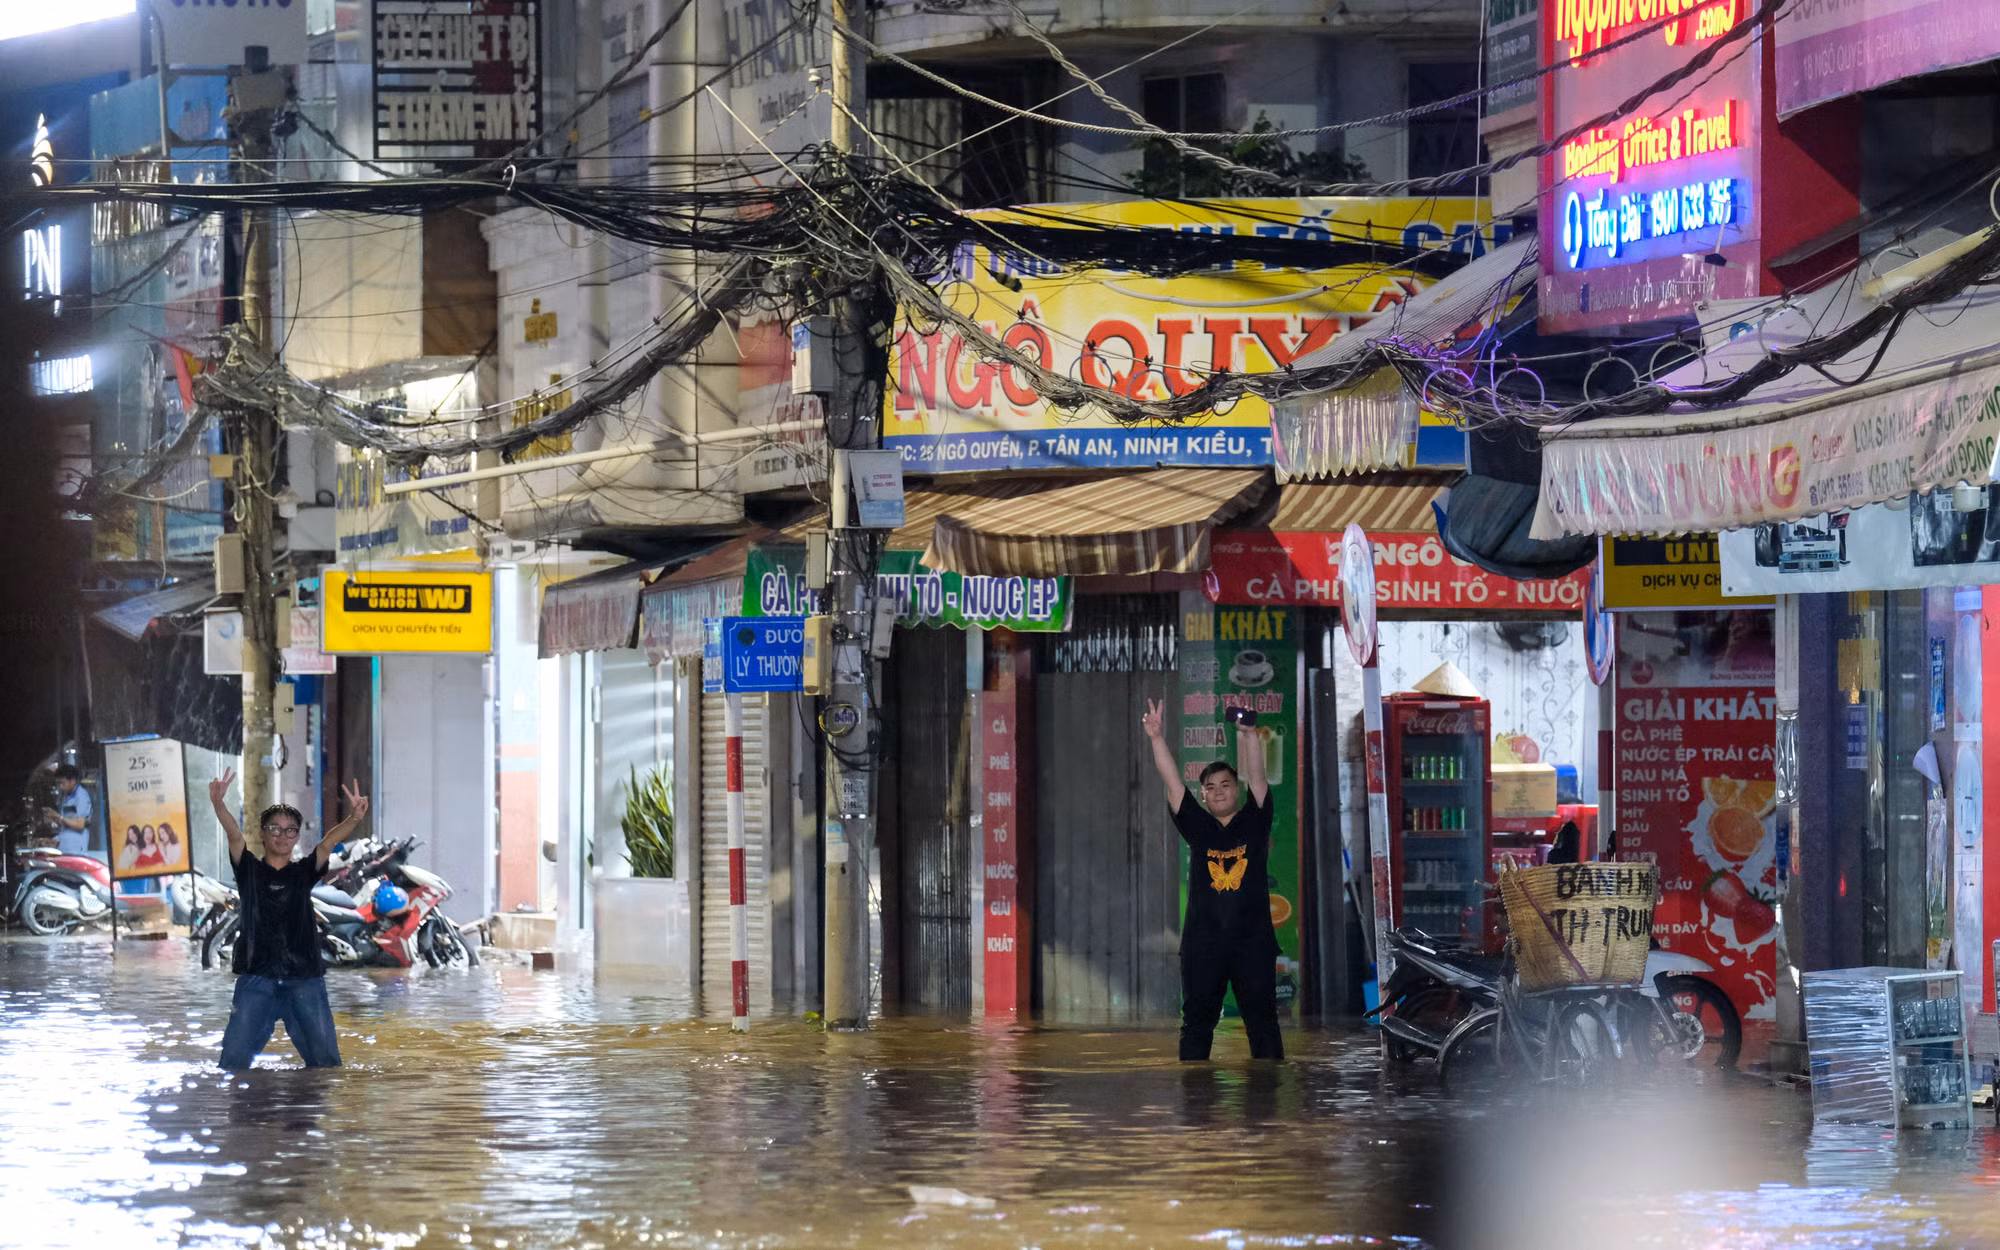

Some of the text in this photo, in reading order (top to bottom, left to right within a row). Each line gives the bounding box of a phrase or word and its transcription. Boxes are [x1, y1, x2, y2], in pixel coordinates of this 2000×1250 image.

[1565, 99, 1732, 184] Booking Office & Travel
[1585, 188, 1618, 258] Tổng
[1650, 187, 1679, 237] 1900
[1682, 182, 1705, 231] 633
[1708, 178, 1732, 224] 365
[894, 298, 1055, 411] NGÔ
[936, 438, 967, 461] NGÔ
[1028, 439, 1041, 457] P.
[1045, 434, 1081, 456] TÂN
[1084, 437, 1119, 458] AN,
[1124, 436, 1179, 456] NINH
[1186, 429, 1253, 457] KIỀU,
[1867, 455, 1916, 497] KARAOKE
[1957, 435, 1995, 480] ĐỘNG
[1374, 537, 1443, 567] NGÔ
[761, 564, 792, 615] CÀ
[1246, 573, 1285, 600] CÀ
[1376, 578, 1441, 601] SINH
[1450, 573, 1489, 602] TỐ
[1642, 574, 1676, 590] DỊCH
[1680, 574, 1700, 589] VỤ
[347, 587, 417, 598] WESTERN
[368, 597, 417, 609] UNION
[352, 623, 376, 635] DỊCH
[1220, 605, 1288, 641] KHÁT
[736, 650, 750, 677] LÝ
[1257, 690, 1284, 714] CÂY
[1623, 690, 1776, 721] GIẢI KHÁT
[992, 714, 1007, 733] CÀ
[1621, 726, 1683, 742] CÀ PHÊ
[989, 752, 1010, 770] PHÊ
[1621, 746, 1671, 762] NƯỚC
[1675, 745, 1697, 762] ÉP
[1702, 745, 1743, 761] TRÁI
[1621, 765, 1688, 782] RAU MÁ
[127, 780, 149, 793] 500
[1621, 783, 1691, 803] SINH TỐ
[988, 792, 1012, 807] SINH
[1622, 807, 1645, 818] MÍT
[993, 822, 1008, 843] TỐ
[1622, 822, 1649, 832] DÂU
[1622, 836, 1642, 847] BƠ
[986, 863, 1015, 879] NƯỚC
[990, 897, 1010, 915] GIẢI
[1672, 921, 1698, 934] DÂY
[987, 931, 1014, 951] KHÁT
